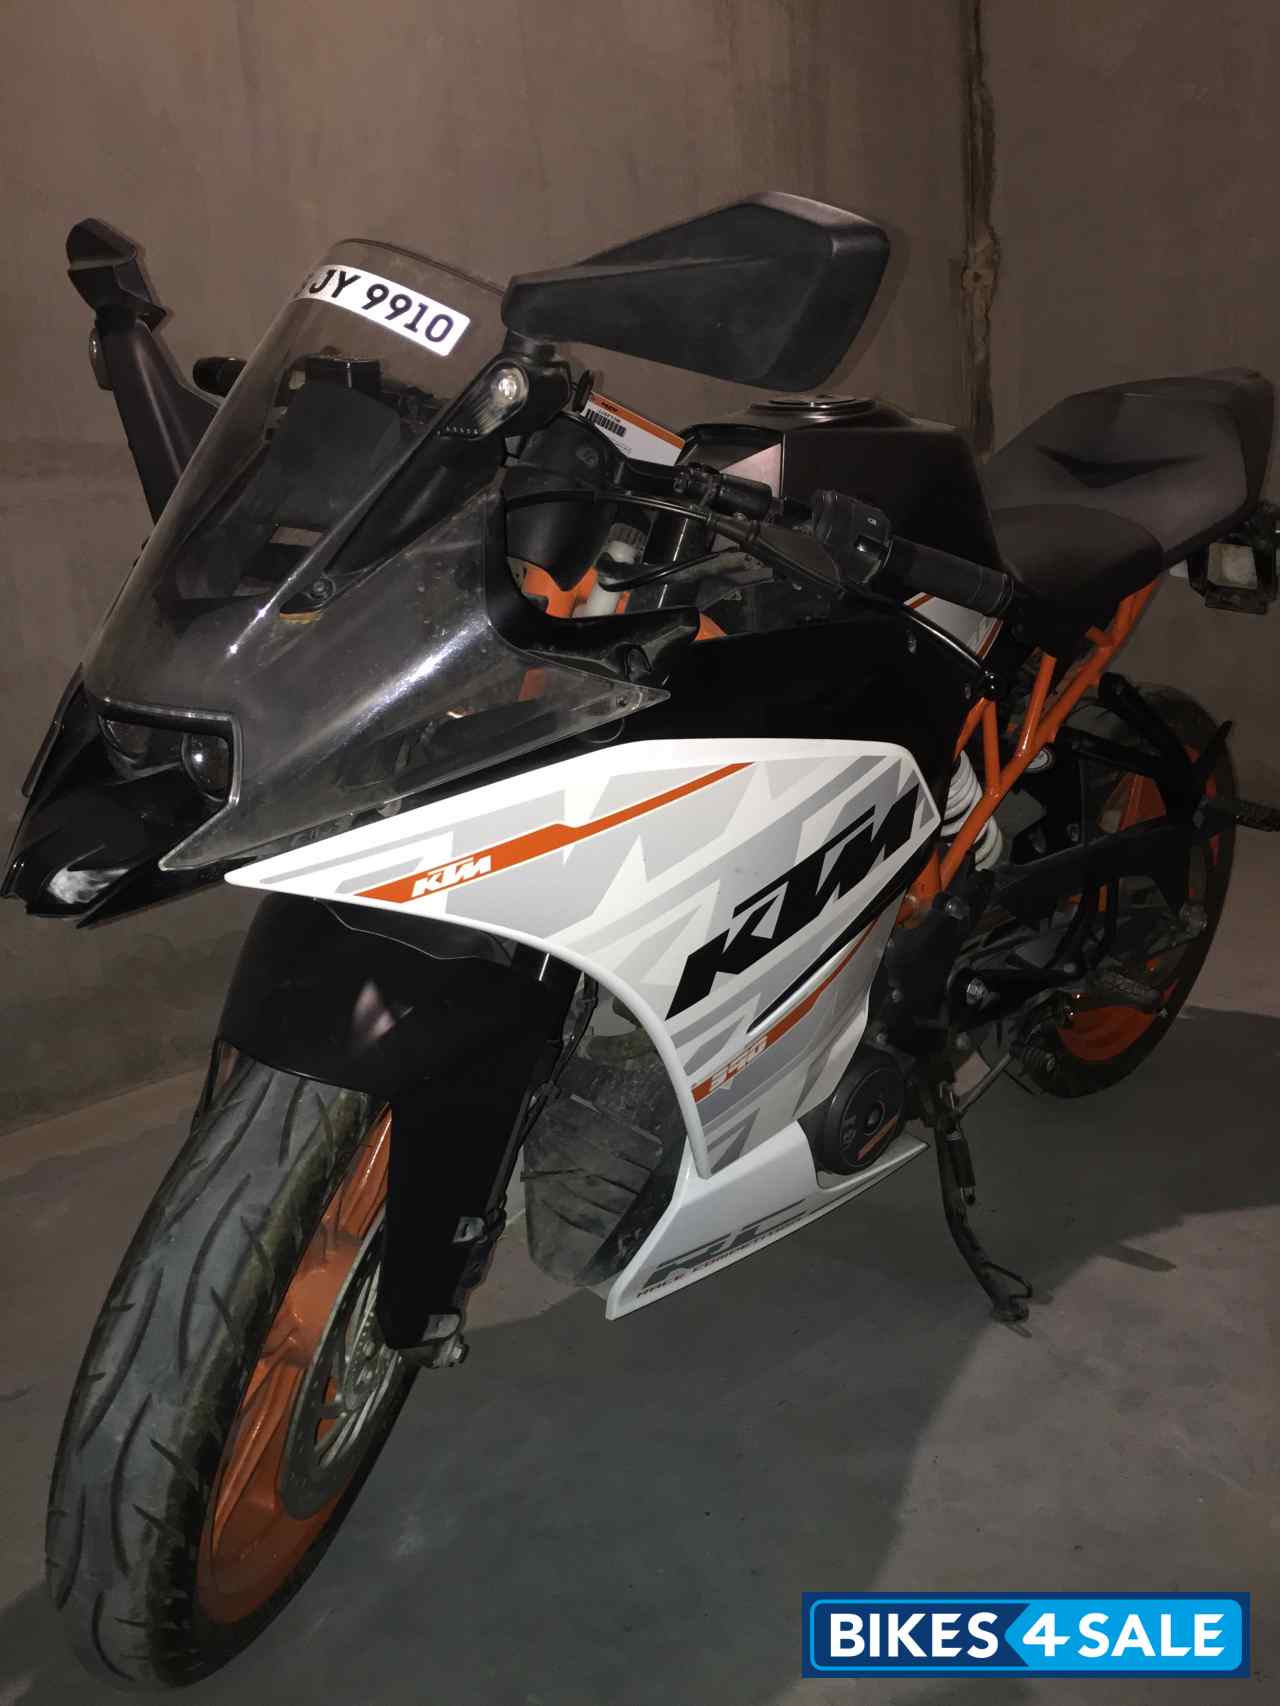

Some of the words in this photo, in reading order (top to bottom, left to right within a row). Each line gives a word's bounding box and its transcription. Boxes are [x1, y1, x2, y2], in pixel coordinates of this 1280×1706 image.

[361, 283, 454, 343] 9910
[411, 855, 491, 898] KTM
[665, 783, 919, 1021] KTM
